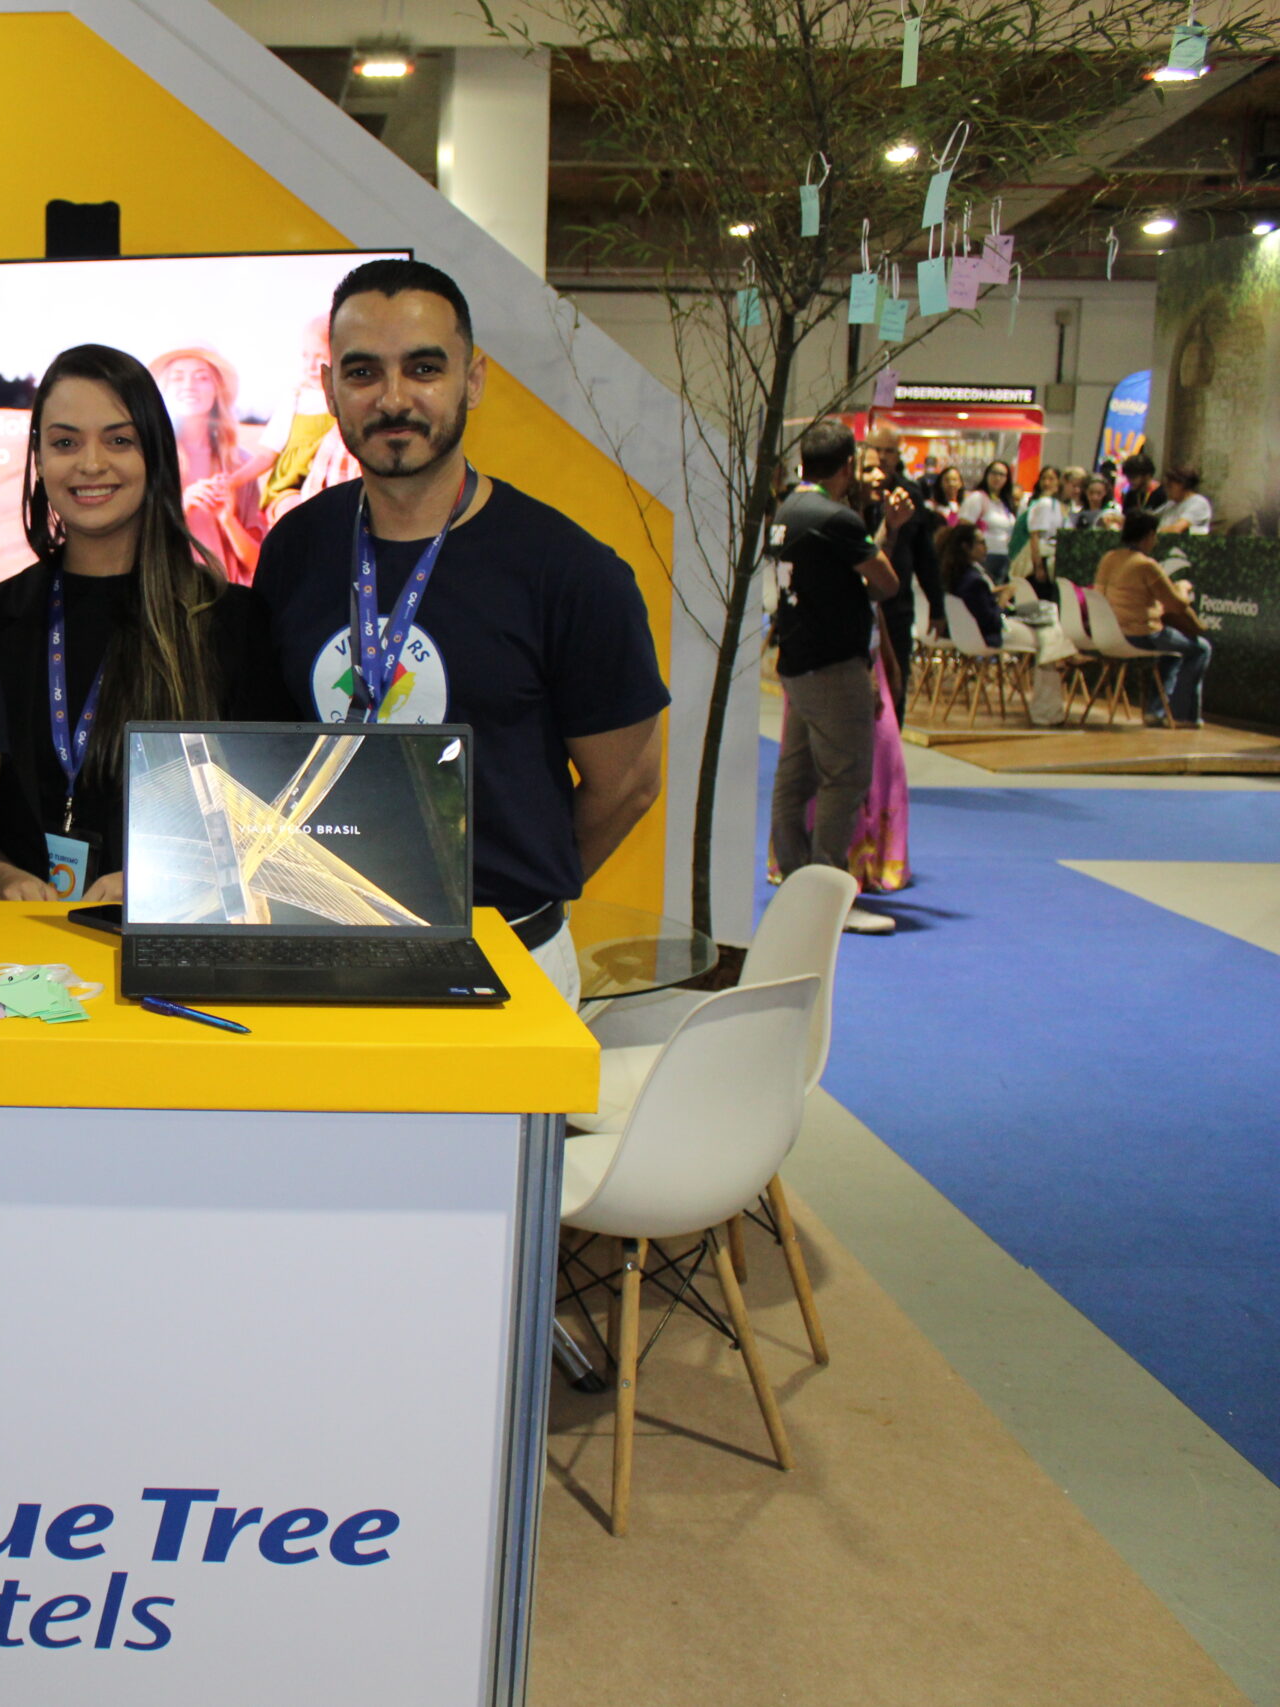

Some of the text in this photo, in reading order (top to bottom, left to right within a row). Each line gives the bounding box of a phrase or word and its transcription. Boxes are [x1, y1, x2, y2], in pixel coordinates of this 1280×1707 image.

[238, 824, 274, 835] VIAJE
[316, 824, 362, 835] BRASIL
[142, 1487, 401, 1568] Tree
